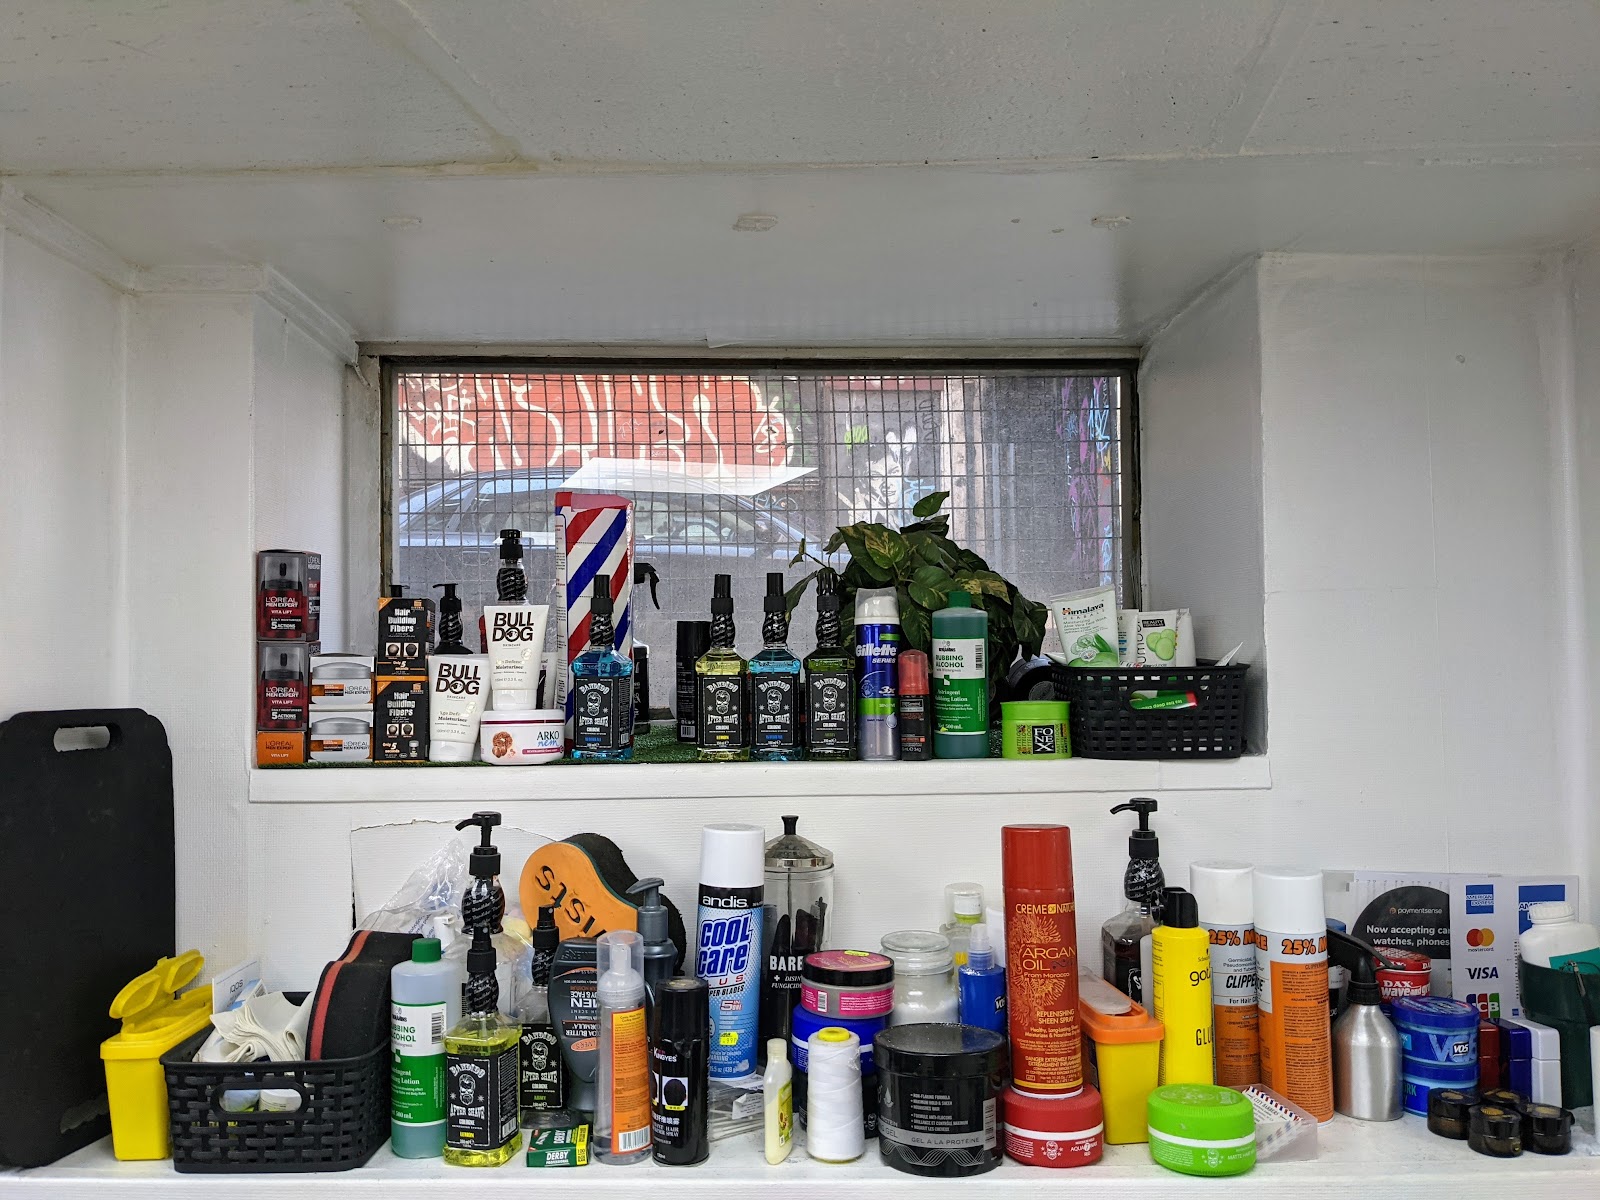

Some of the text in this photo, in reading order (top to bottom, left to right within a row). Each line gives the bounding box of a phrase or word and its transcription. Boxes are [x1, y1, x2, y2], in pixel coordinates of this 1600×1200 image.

[394, 608, 411, 616] Hair
[1062, 603, 1104, 616] Himalaya
[270, 621, 278, 630] 5
[388, 616, 416, 624] Building
[494, 612, 534, 628] BULL
[390, 624, 414, 632] Fibers
[492, 626, 534, 642] DOG
[856, 643, 898, 657] Gillette
[438, 662, 482, 680] BULL
[436, 678, 480, 696] DOG
[394, 692, 410, 700] Hair
[386, 700, 416, 708] Building
[272, 712, 278, 720] 5
[388, 708, 414, 716] Fibers
[814, 711, 846, 722] AFTER SHAVE
[579, 716, 608, 727] AFTER SHAVE
[708, 714, 738, 725] AFTER SHAVE
[759, 713, 790, 724] AFTER SHAVE
[536, 730, 560, 740] ARKO
[702, 896, 747, 908] andis
[1016, 904, 1048, 914] CREME
[1057, 902, 1075, 914] NATUR
[1366, 925, 1389, 934] Now
[1390, 926, 1436, 936] accepting
[1208, 929, 1241, 946] 25%
[1373, 937, 1450, 947] watches, phones
[1022, 946, 1076, 959] ARGAN
[1281, 938, 1316, 956] 25%
[1022, 959, 1051, 971] OIL
[1422, 962, 1431, 970] DA
[1465, 967, 1499, 980] VISA
[1383, 980, 1412, 988] DAX
[722, 985, 745, 996] BLADES
[1381, 987, 1411, 997] wave
[721, 1000, 732, 1010] 5
[1475, 1002, 1499, 1012] CB
[1036, 1008, 1075, 1018] REPLENISHING
[1060, 1016, 1074, 1024] SPRAY
[391, 1024, 416, 1033] UBBING
[392, 1033, 416, 1042] COHOL
[1453, 1043, 1469, 1054] VO5
[522, 1070, 558, 1084] AFTER SHAVE
[1406, 1084, 1416, 1096] RK
[450, 1103, 485, 1120] AFTER SHAVE
[886, 1128, 898, 1138] GEL
[546, 1152, 568, 1160] DERBY
